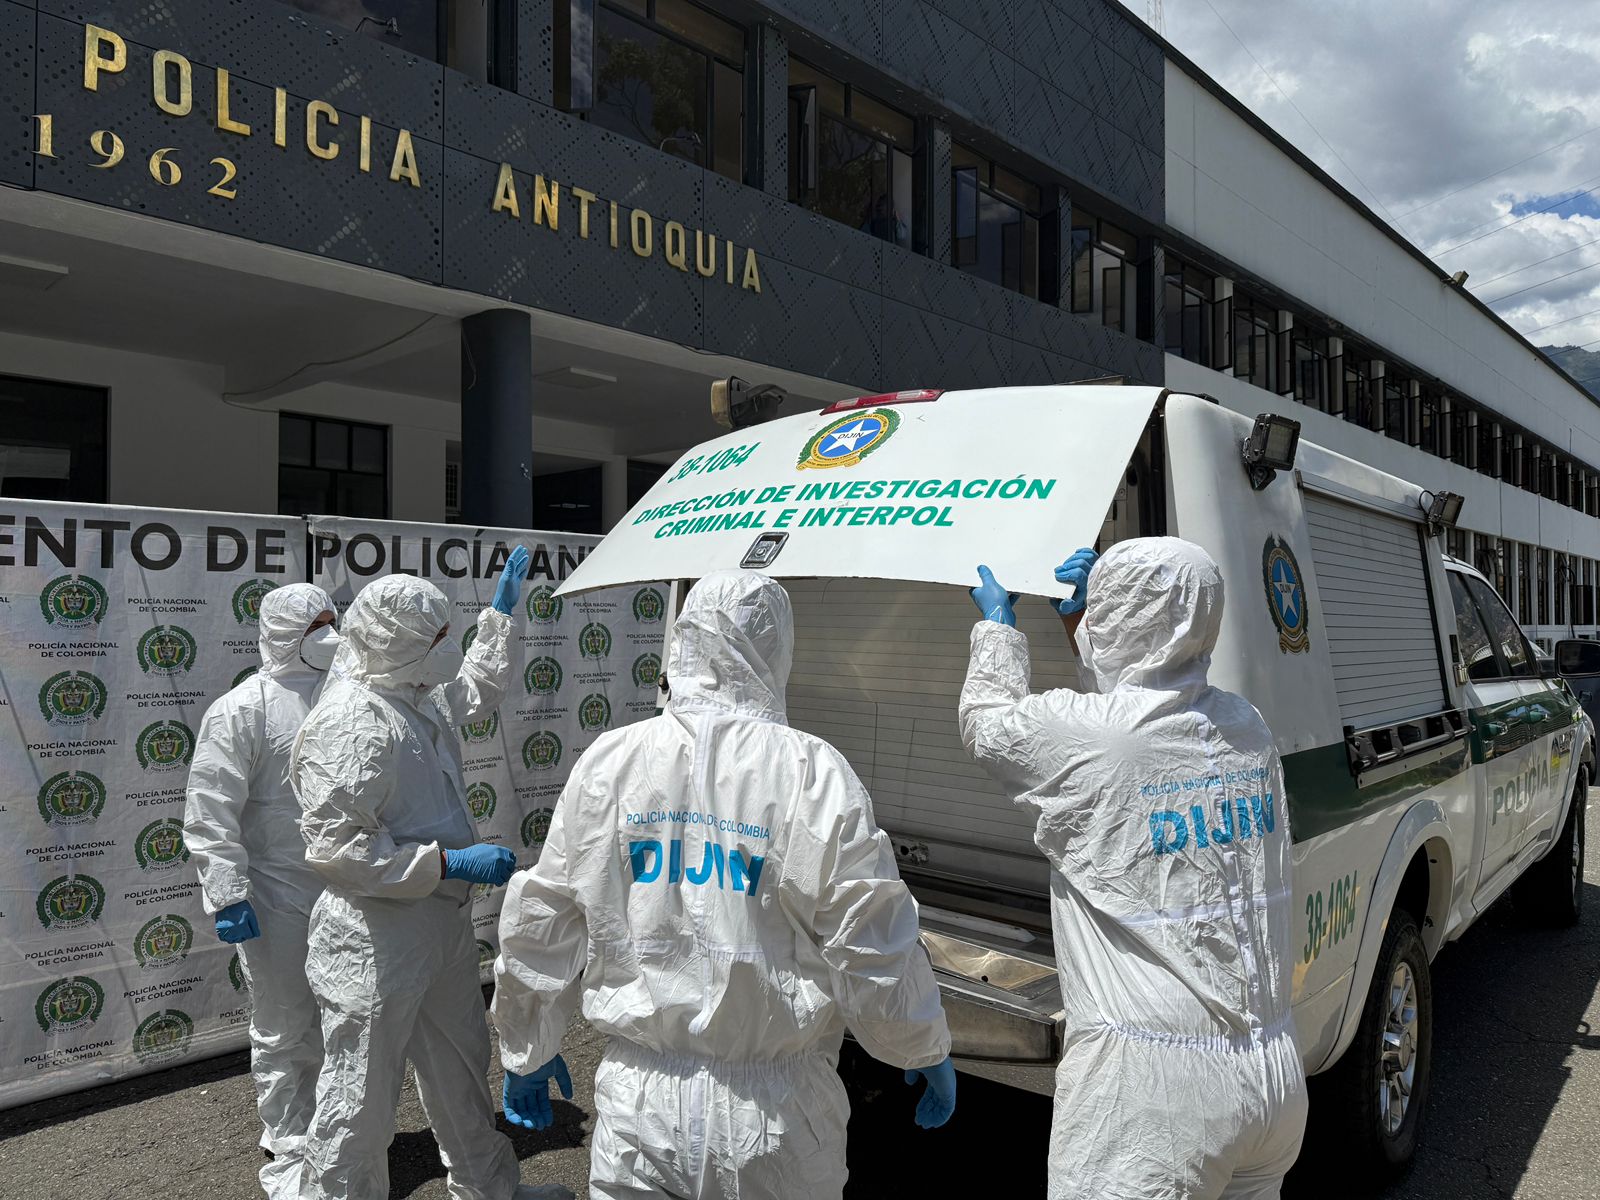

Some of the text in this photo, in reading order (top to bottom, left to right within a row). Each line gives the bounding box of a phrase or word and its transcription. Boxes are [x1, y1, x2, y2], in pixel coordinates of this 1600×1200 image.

[32, 113, 238, 200] 1962
[83, 23, 761, 293] POLICIA ANTIOQUIA
[667, 441, 762, 484] 38-1064
[632, 474, 1057, 525] DIRECCIÓN DE INVESTIGACIÓN
[654, 505, 954, 539] CRIMINAL E INTERPOL
[207, 526, 286, 574] DE
[315, 529, 510, 579] POLICÍA
[526, 543, 595, 580] AN
[28, 642, 67, 650] POLICÍA
[126, 691, 206, 700] POLICÍA NACIONAL
[151, 699, 195, 707] COLOMBIA
[27, 739, 118, 751] POLICÍA NACIONAL
[55, 748, 106, 757] COLOMBIA
[469, 762, 497, 771] COLOMBIA
[1225, 772, 1236, 783] DE
[125, 789, 159, 800] POLICÍA
[1492, 755, 1549, 826] POLICÍA
[707, 814, 717, 828] DE
[719, 819, 770, 841] COLOMBIA
[1149, 791, 1275, 857] DIJIN
[26, 840, 116, 856] POLICÍA NACIONAL
[54, 849, 105, 861] COLOMBIA
[629, 839, 765, 897] DIJIN
[124, 888, 159, 899] POLICÍA
[149, 891, 193, 903] COLOMBIA
[1304, 870, 1357, 964] 38-1064
[24, 941, 116, 960] POLICÍA NACIONAL
[37, 951, 104, 967] DE COLOMBIA
[123, 976, 204, 998] POLICÍA NACIONAL
[135, 986, 193, 1004] DE COLOMBIA
[24, 1040, 115, 1064] POLICÍA NACIONAL
[37, 1051, 102, 1070] DE COLOMBIA
